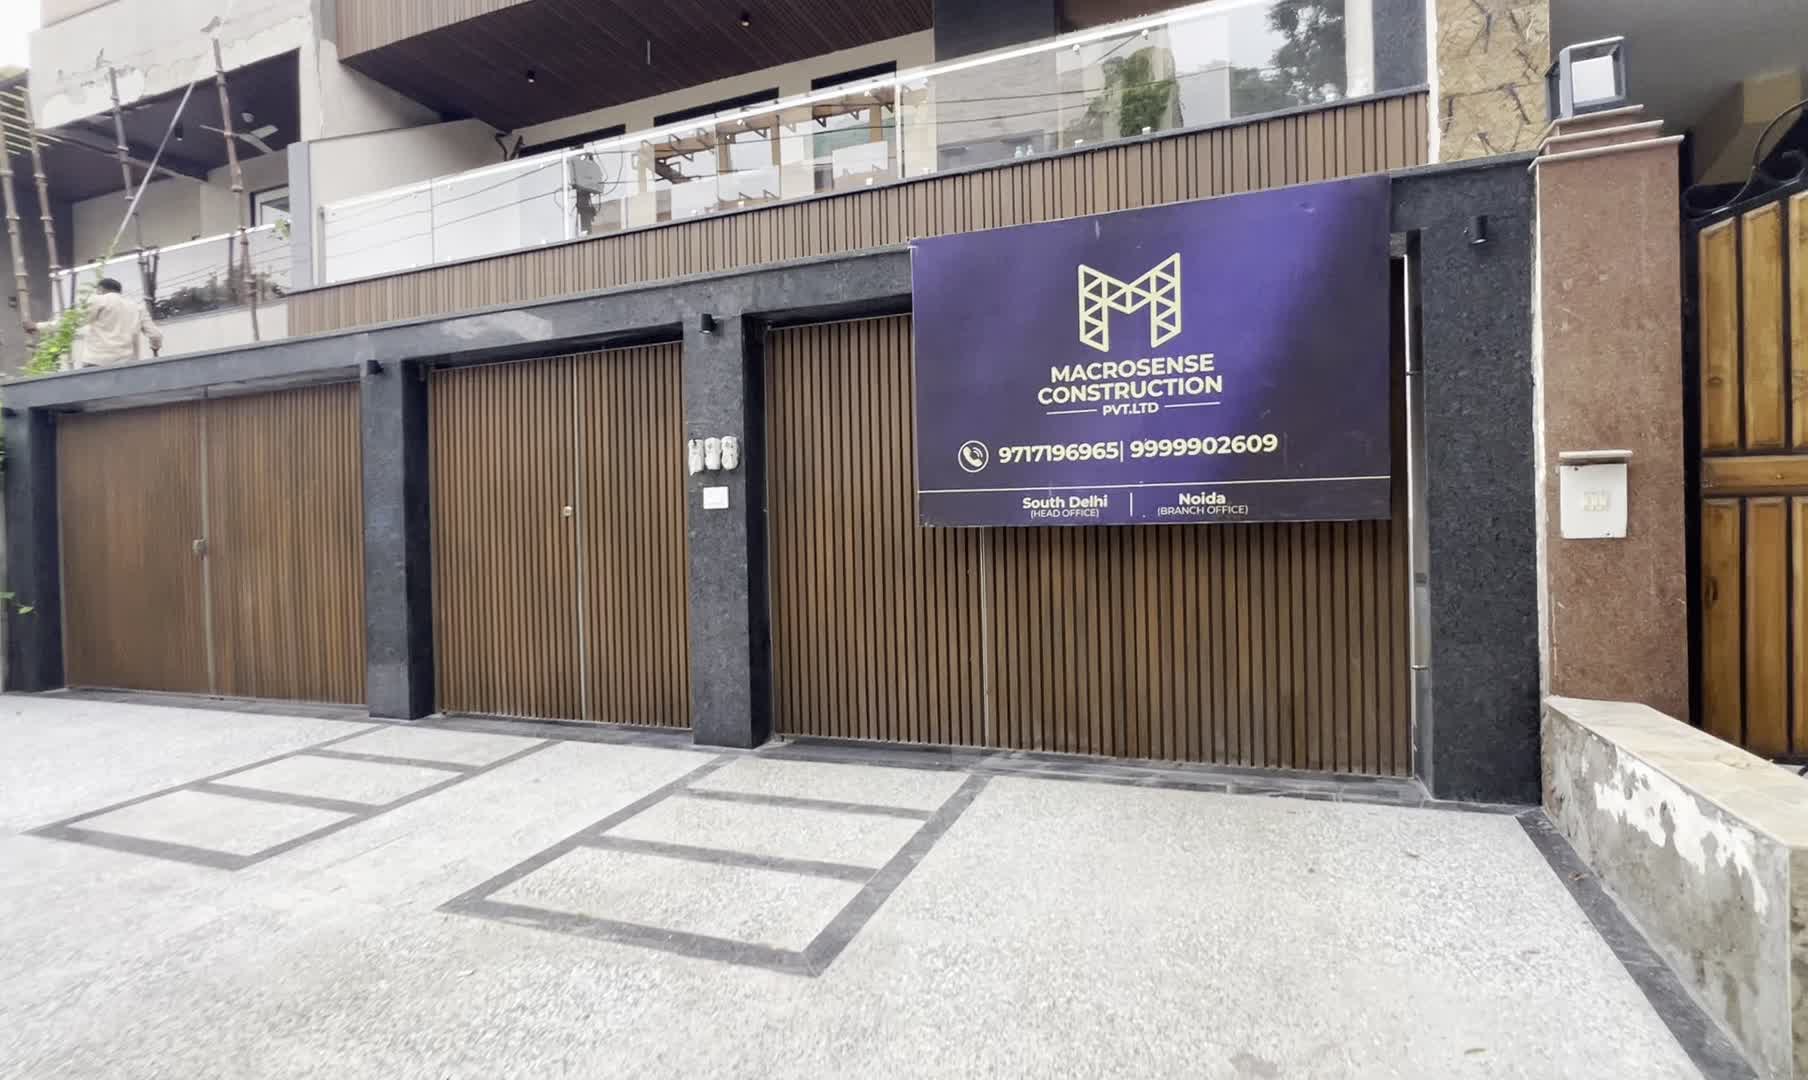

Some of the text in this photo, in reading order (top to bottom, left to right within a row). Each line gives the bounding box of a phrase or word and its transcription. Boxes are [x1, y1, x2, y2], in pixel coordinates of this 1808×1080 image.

[1050, 353, 1215, 383] MACROSENSE
[1037, 375, 1223, 405] CONSTRUCTION
[1102, 402, 1160, 416] PVT.LTD
[1129, 433, 1279, 459] 9999902609
[1022, 494, 1108, 509] South Delhi
[1178, 491, 1227, 506] Noida
[1030, 507, 1100, 519] (HEAD OFFICE)
[1157, 504, 1249, 517] (BRANCH OFFICE)
